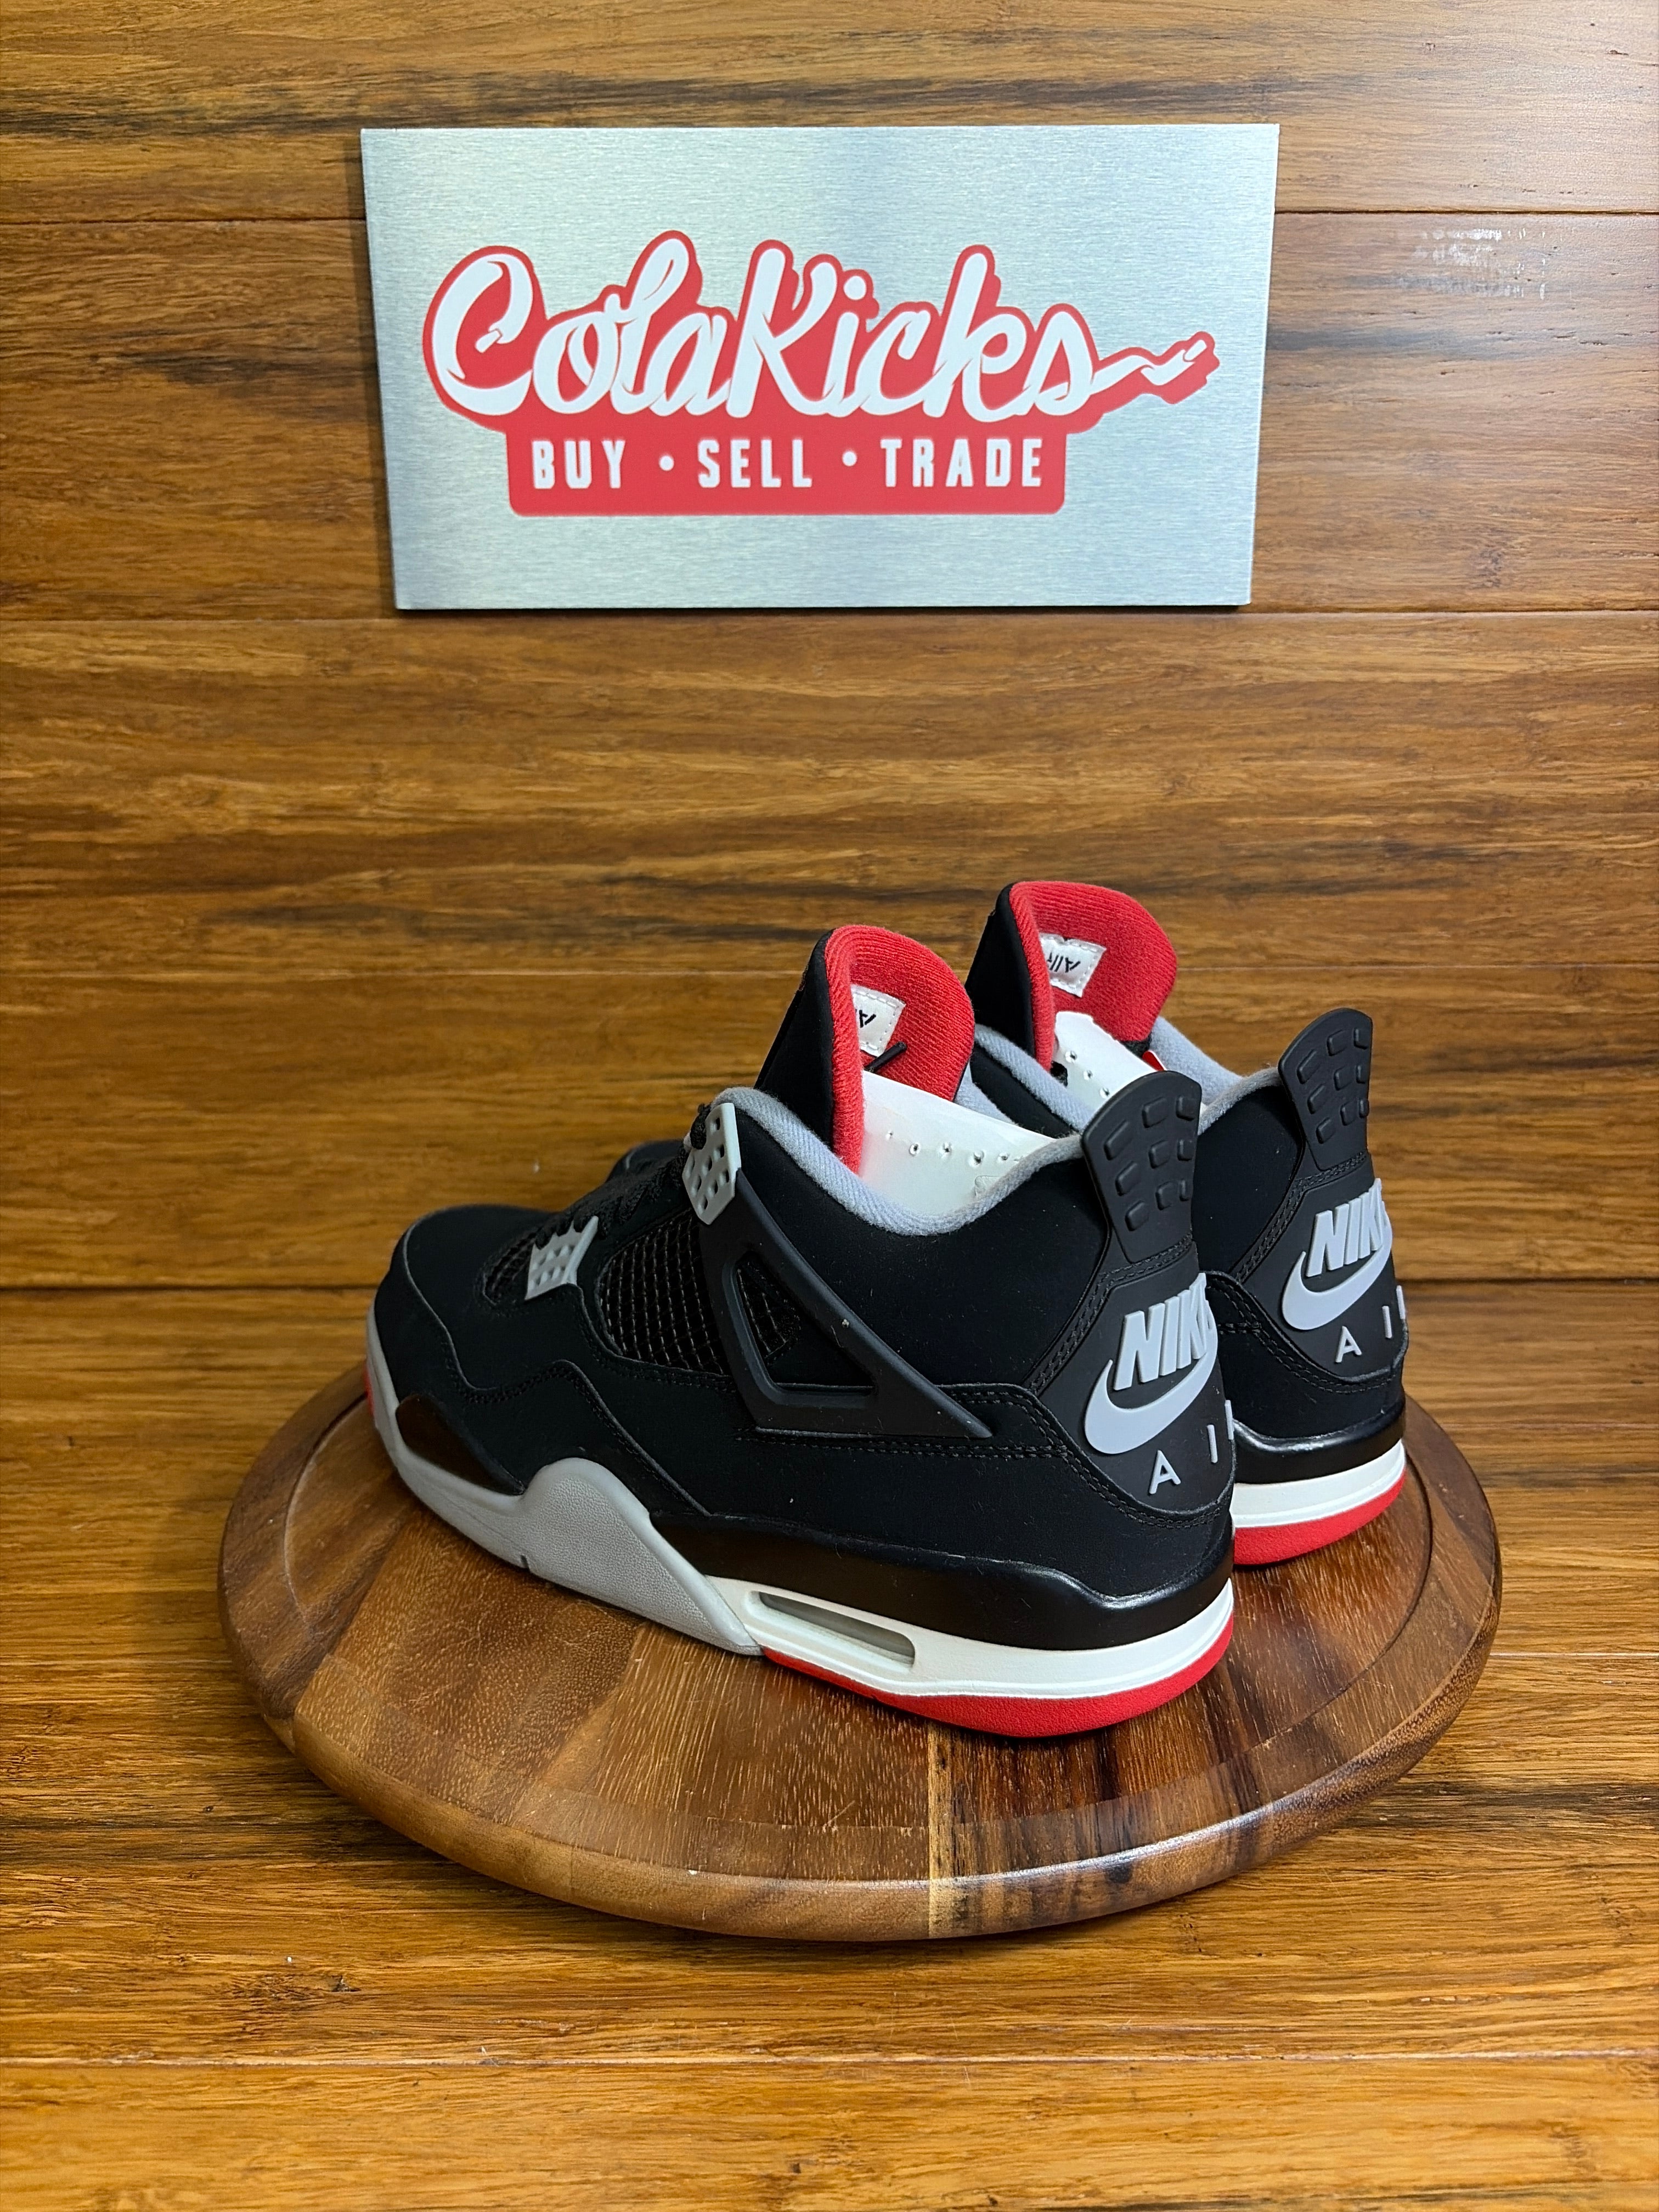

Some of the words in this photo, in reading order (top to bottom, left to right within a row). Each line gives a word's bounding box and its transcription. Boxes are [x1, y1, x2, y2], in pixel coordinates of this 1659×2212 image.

[432, 237, 1207, 422] ColaKicks
[532, 440, 626, 489] BUY
[698, 439, 812, 488] SELL
[881, 438, 1042, 488] TRADE
[1305, 1177, 1386, 1278] NIK
[1113, 1272, 1210, 1391] NIK
